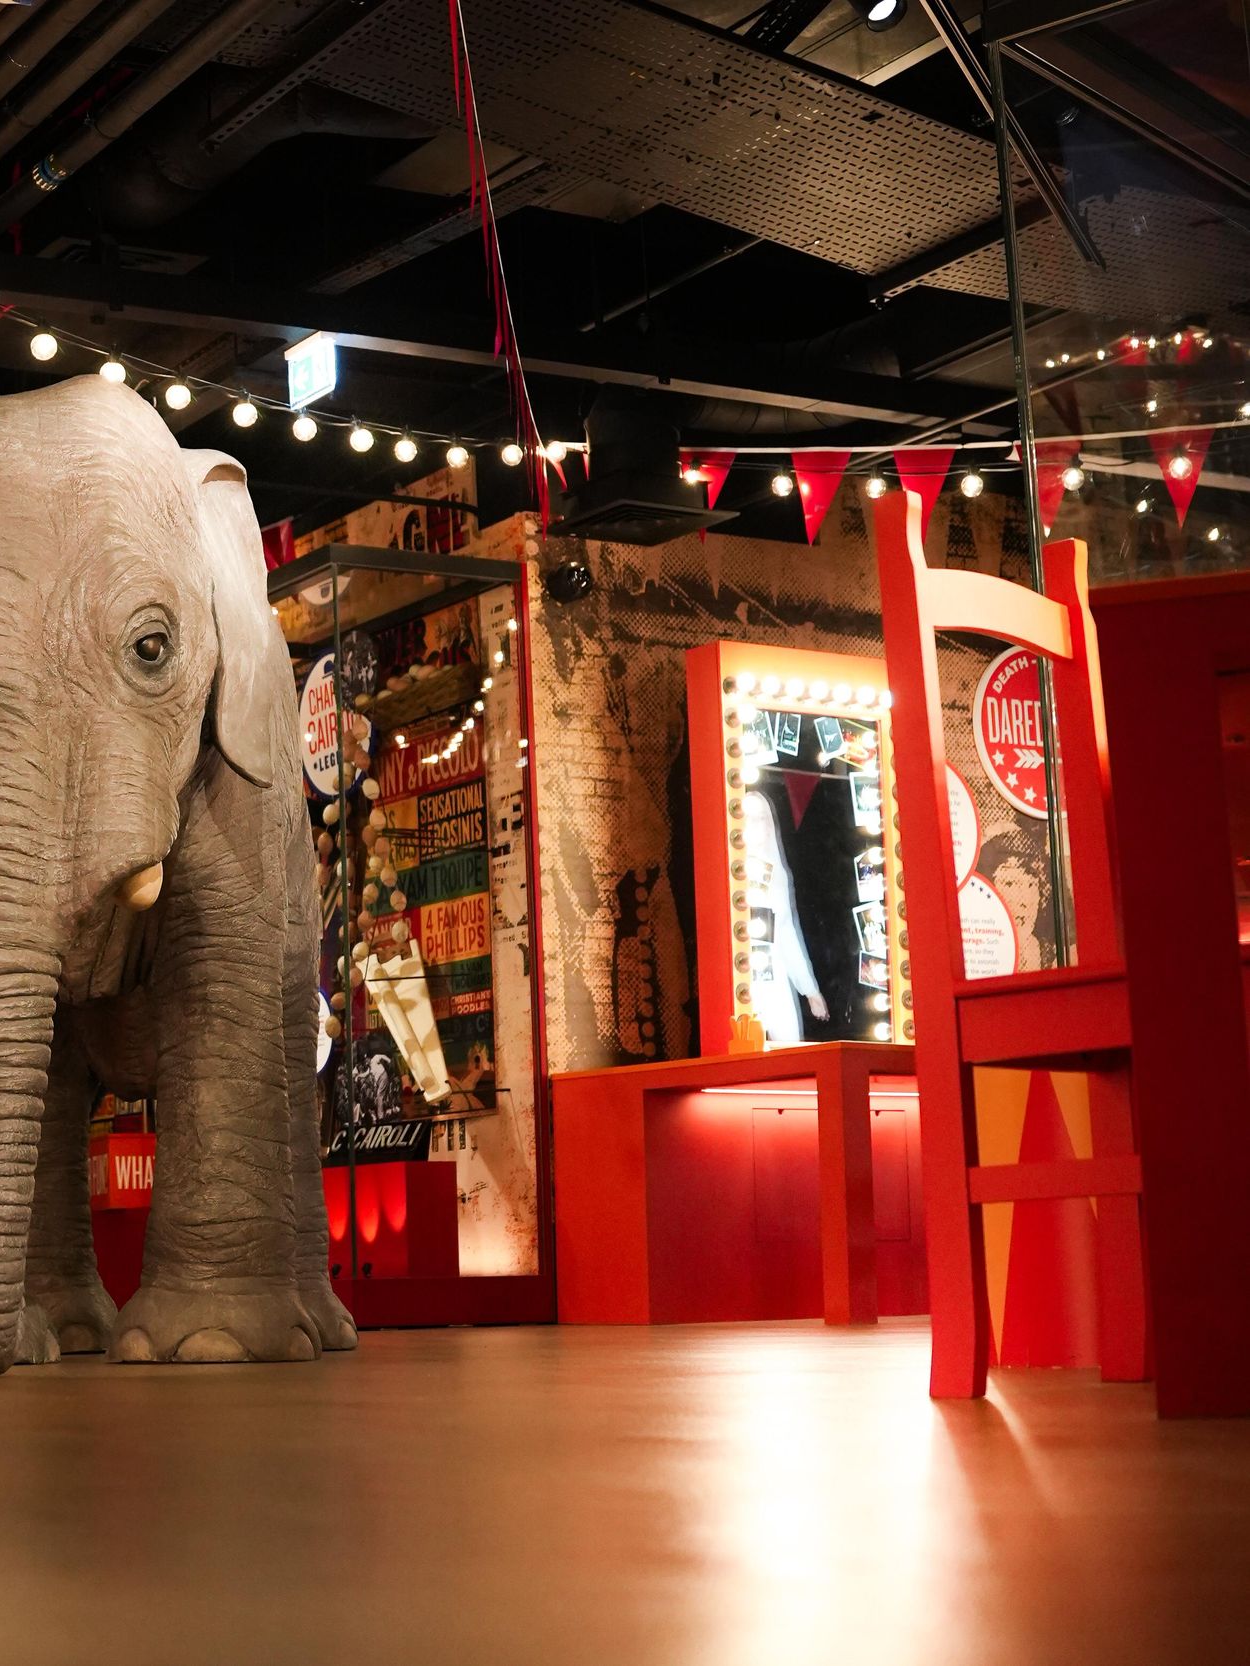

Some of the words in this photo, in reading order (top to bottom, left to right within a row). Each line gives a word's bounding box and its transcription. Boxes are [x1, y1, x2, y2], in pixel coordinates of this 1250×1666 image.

[992, 655, 1029, 694] DEATH
[419, 782, 484, 824] SENSATIONAL
[430, 855, 484, 898] TROUPE
[425, 909, 434, 935] 4
[437, 897, 486, 933] FAMOUS
[426, 924, 486, 962] PHILLIPS
[352, 1121, 424, 1151] CAIROLI
[114, 1154, 155, 1191] WHA
